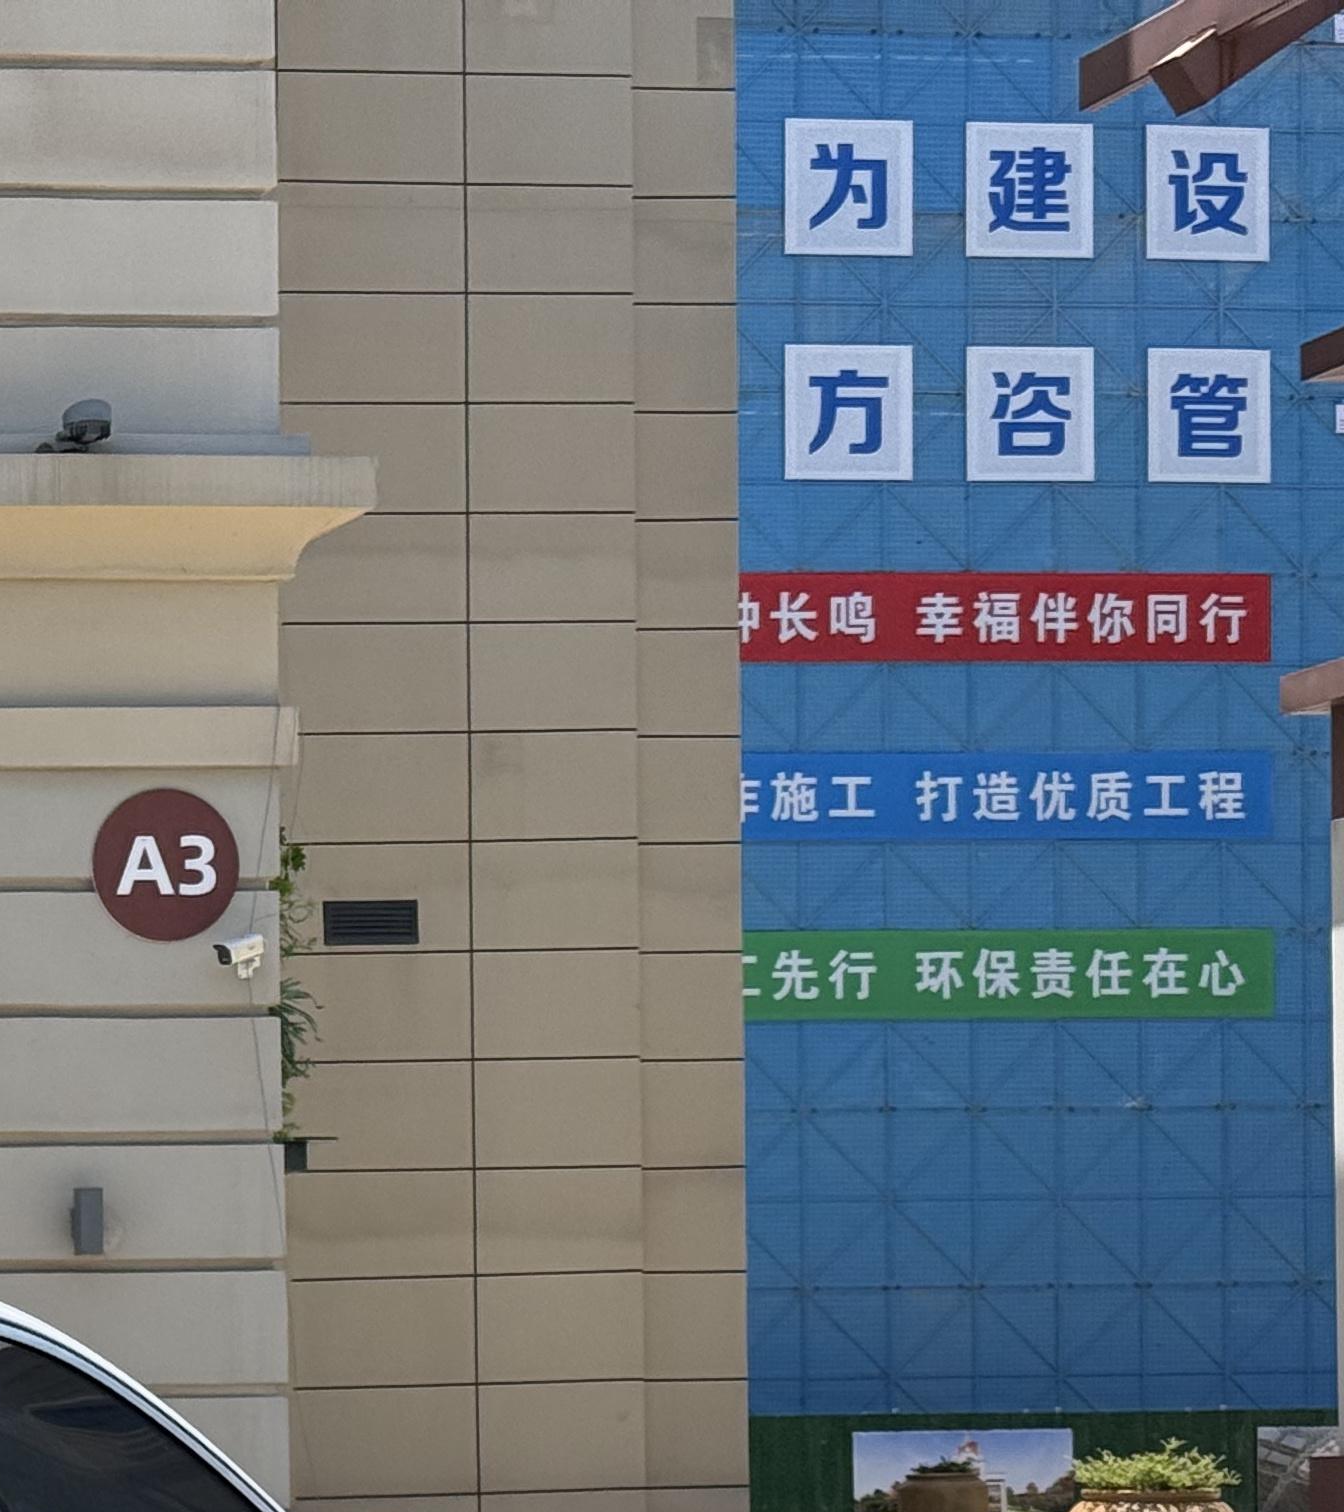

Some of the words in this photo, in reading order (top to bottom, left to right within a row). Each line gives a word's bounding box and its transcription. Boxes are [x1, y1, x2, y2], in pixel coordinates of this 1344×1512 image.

[916, 591, 1248, 644] 幸福伴你同行
[915, 771, 1247, 823] 打造优质工程
[116, 834, 217, 896] A3
[915, 948, 1246, 1000] 环保责任在心
